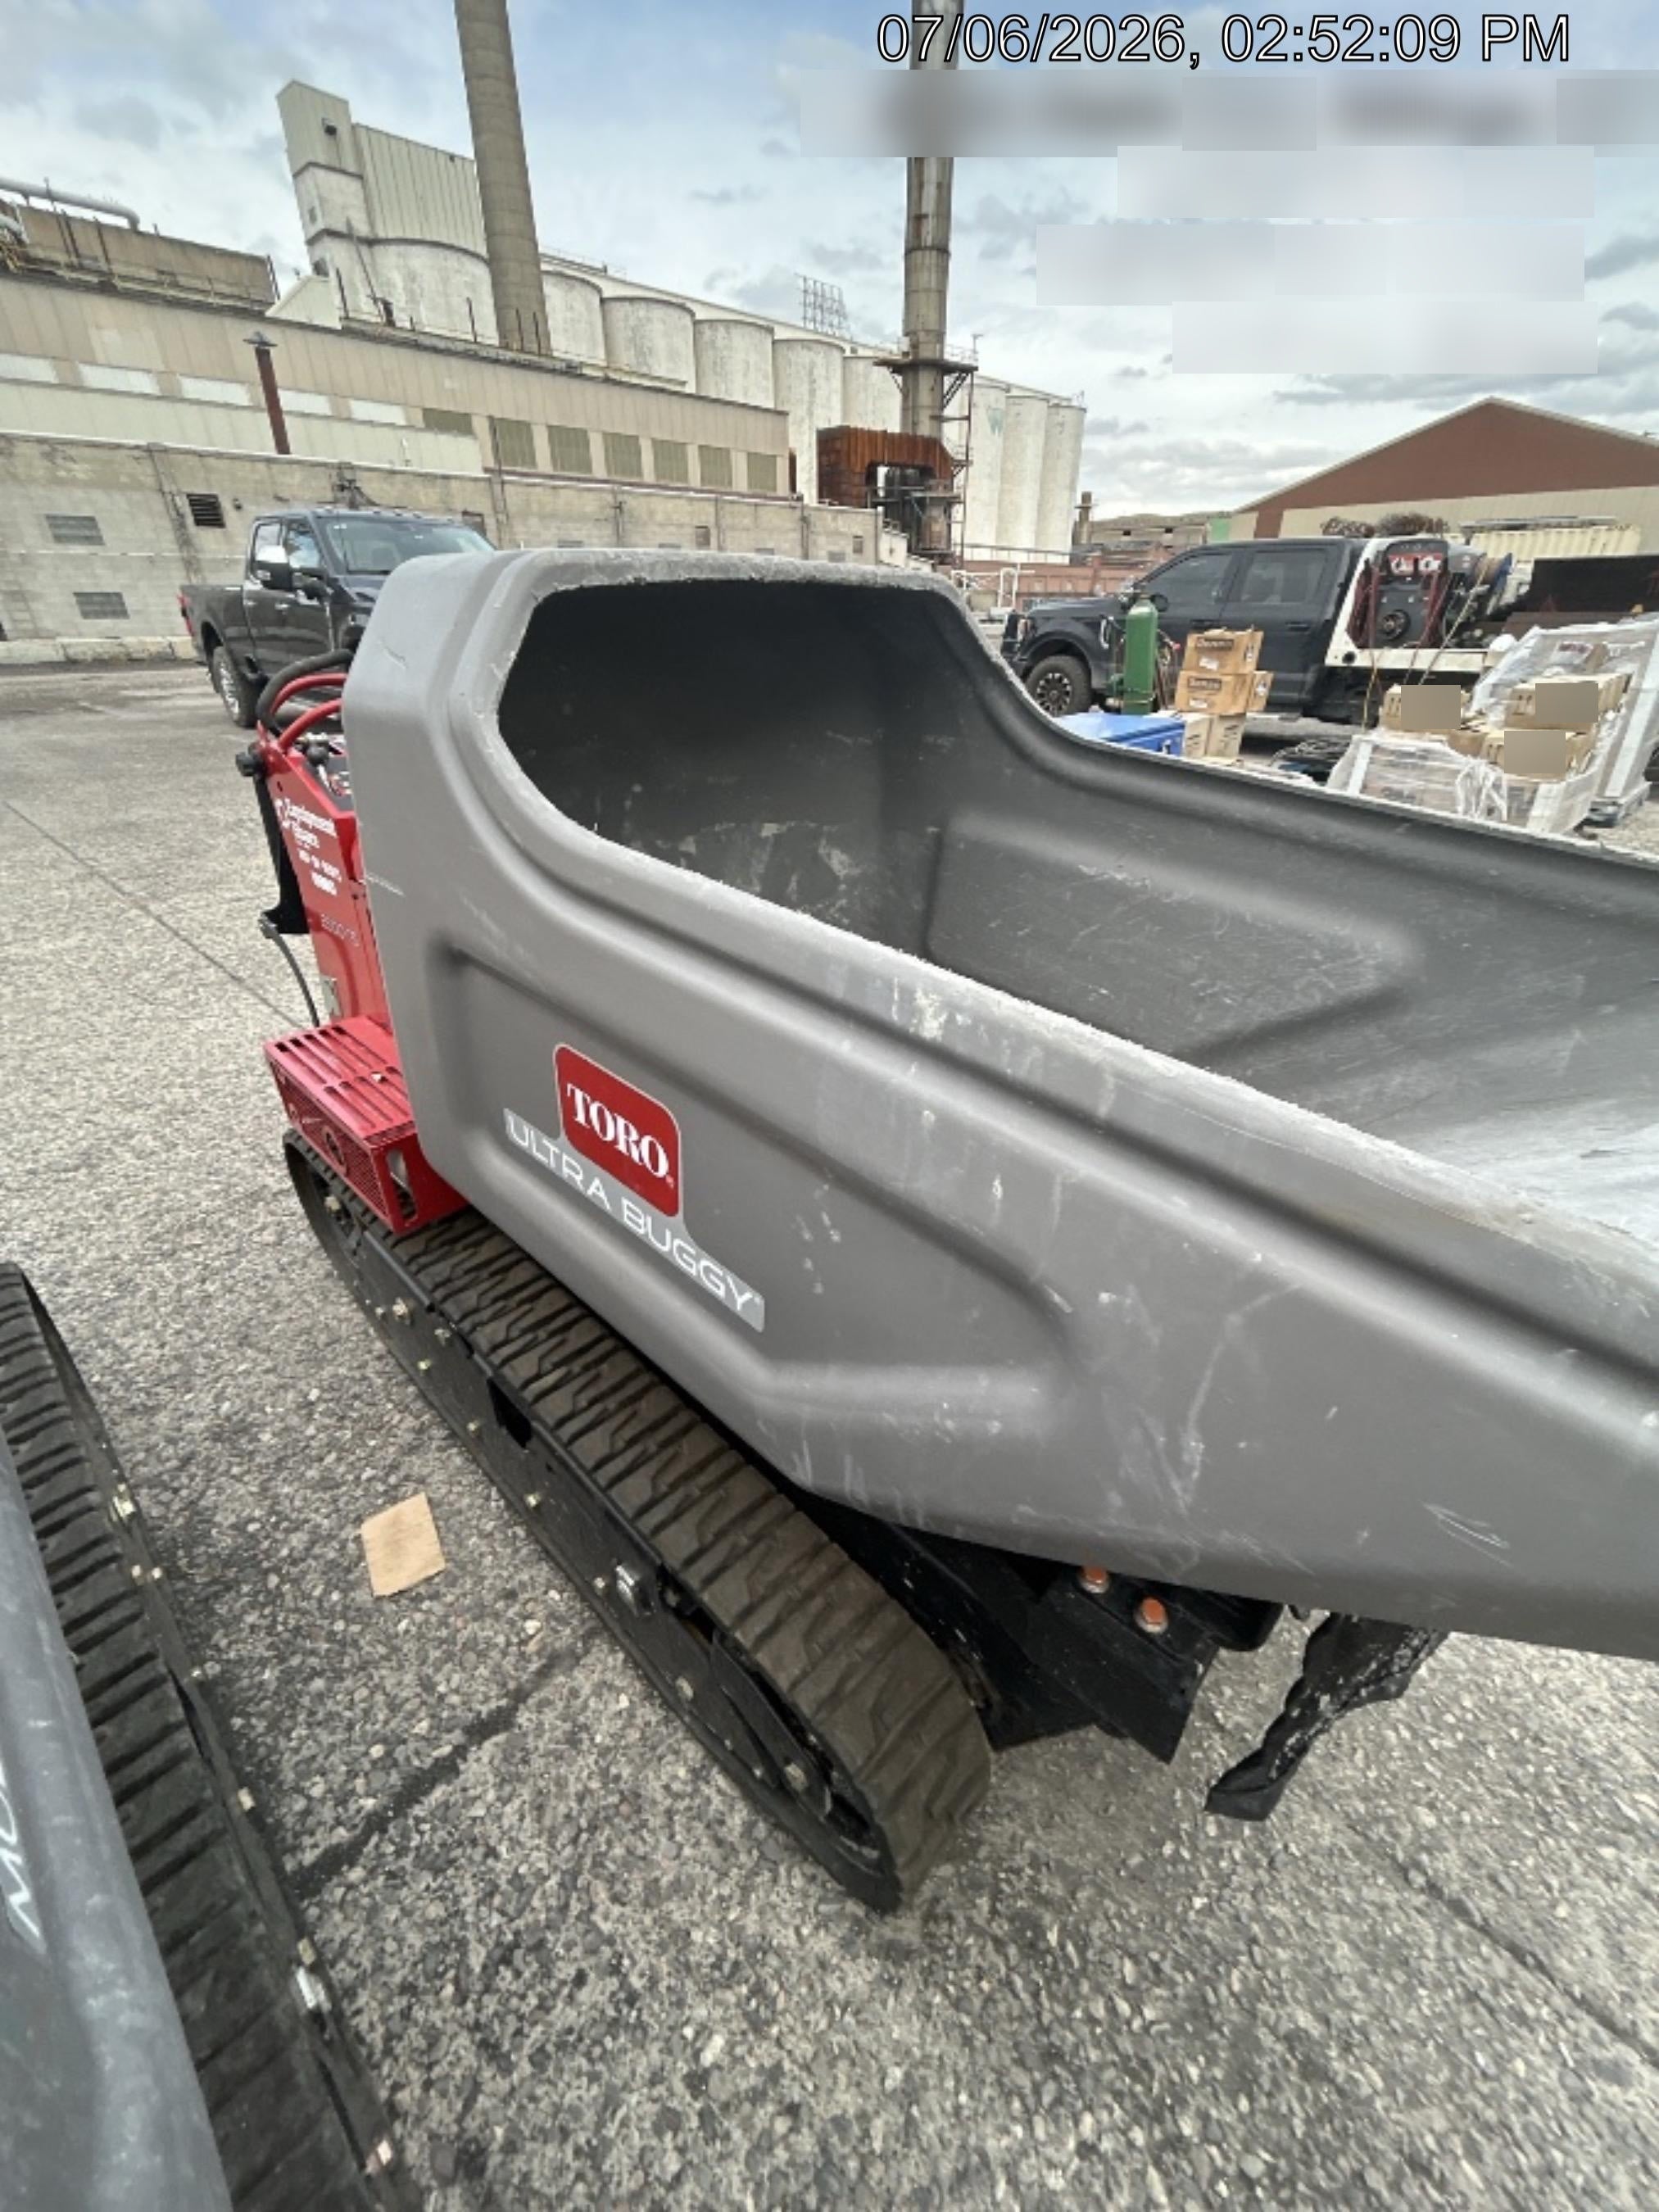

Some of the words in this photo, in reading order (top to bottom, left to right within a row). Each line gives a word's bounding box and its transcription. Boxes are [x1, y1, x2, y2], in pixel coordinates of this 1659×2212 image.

[566, 1082, 670, 1180] TORO
[507, 1114, 613, 1211] ULTRA
[622, 1196, 753, 1312] BUGGY
